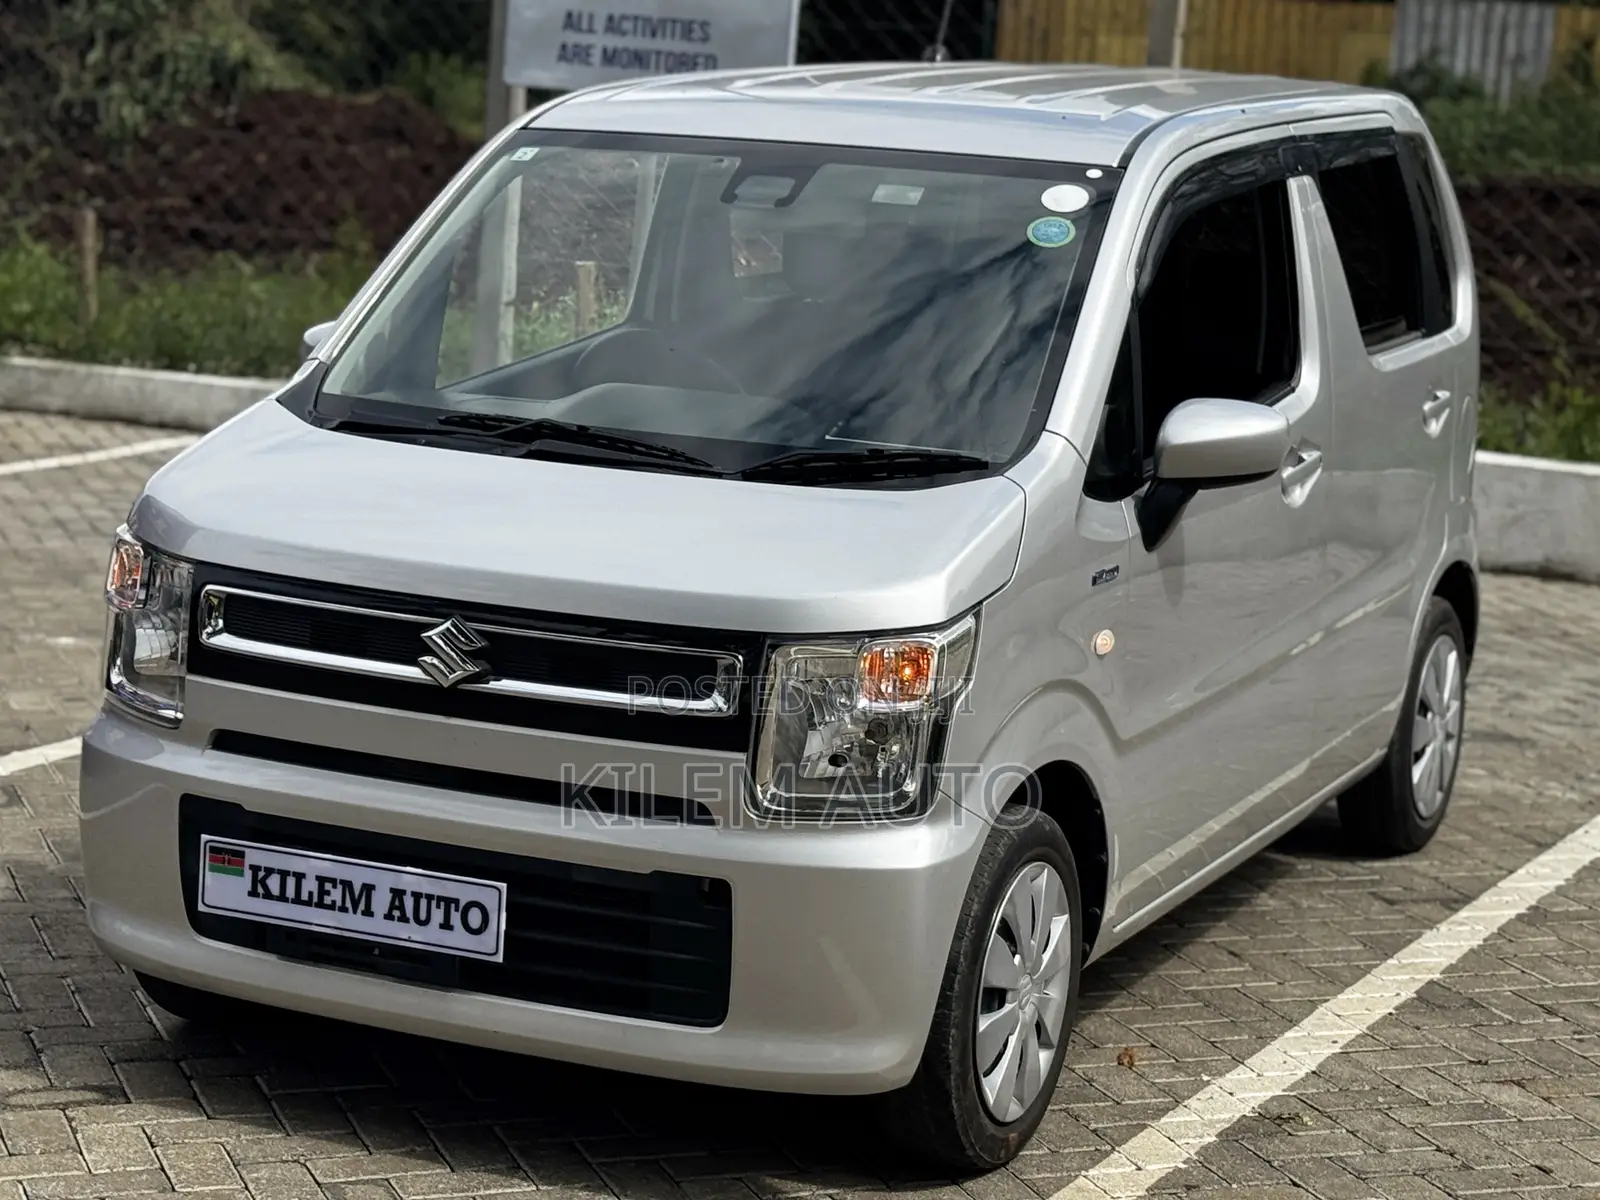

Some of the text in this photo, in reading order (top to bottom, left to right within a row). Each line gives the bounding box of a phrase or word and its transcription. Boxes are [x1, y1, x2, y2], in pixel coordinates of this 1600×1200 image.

[561, 10, 711, 44] ALL ACTIVITIES
[556, 42, 718, 74] ARE MONITORED
[247, 864, 490, 936] KILEM AUTO
